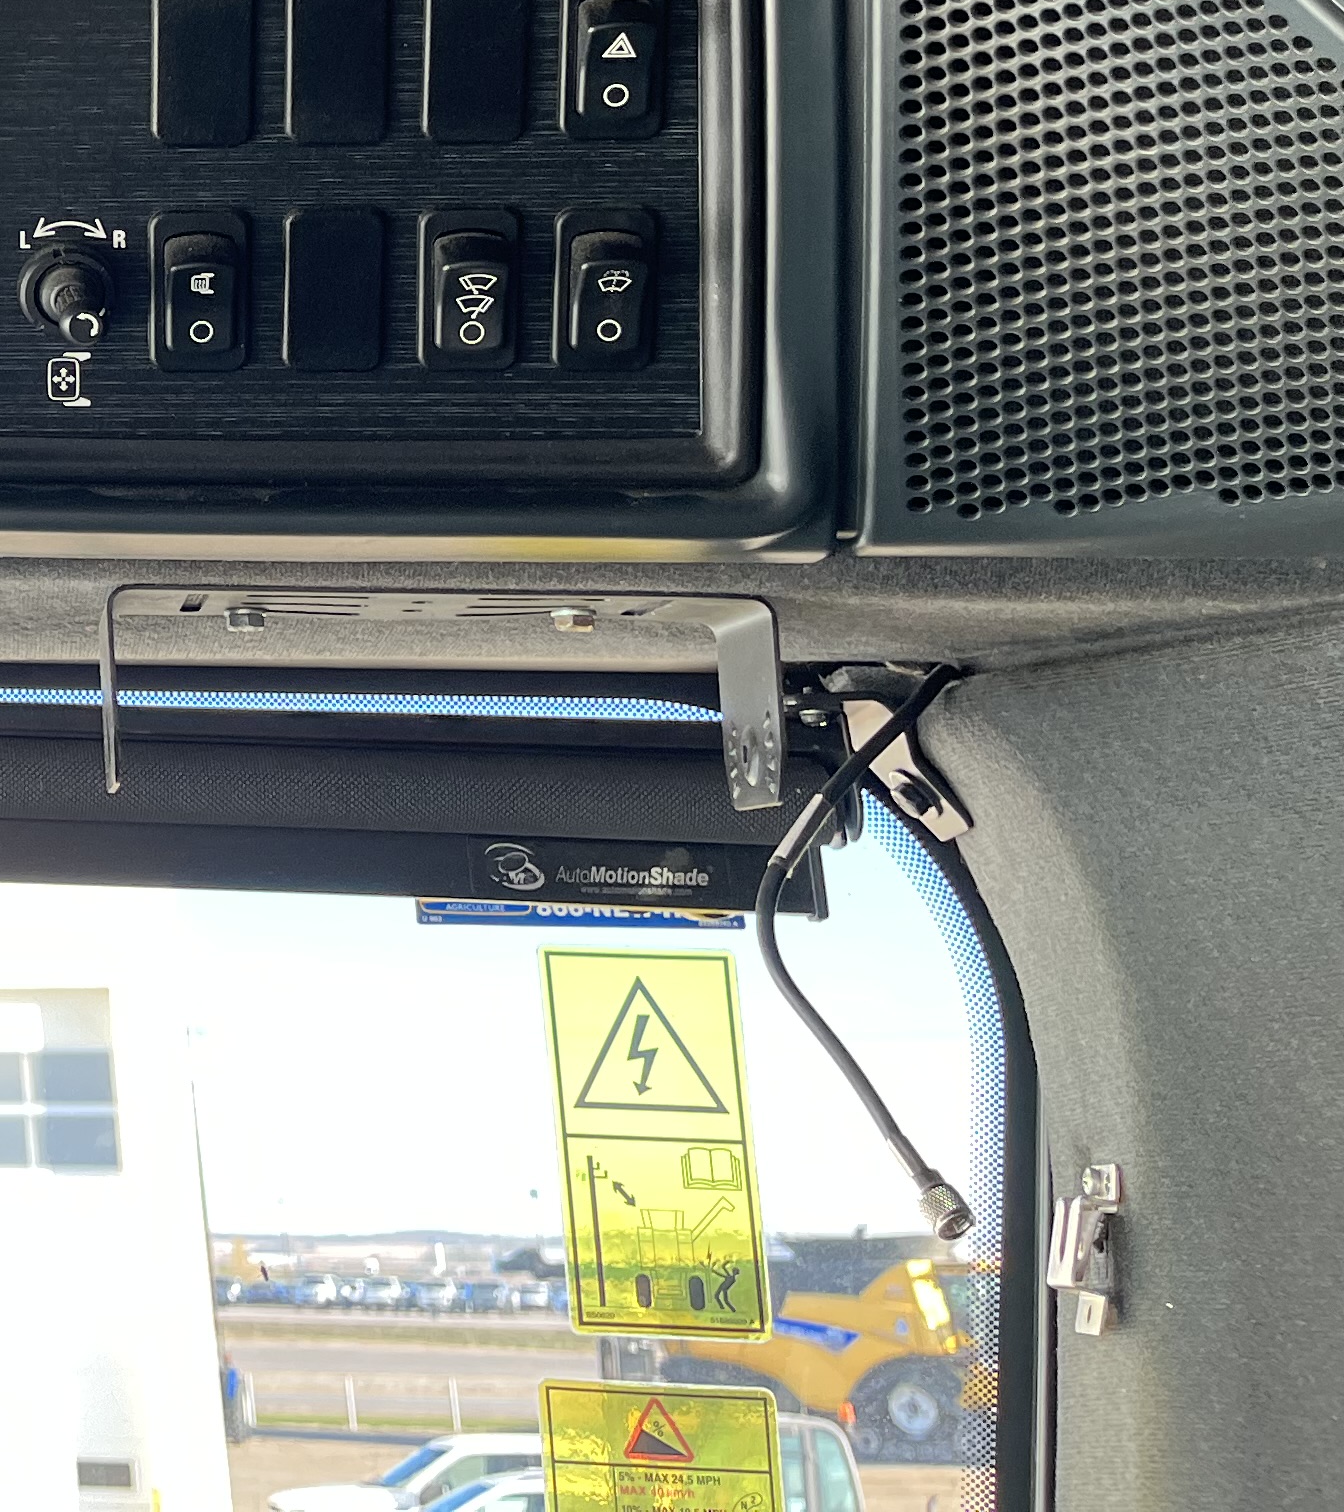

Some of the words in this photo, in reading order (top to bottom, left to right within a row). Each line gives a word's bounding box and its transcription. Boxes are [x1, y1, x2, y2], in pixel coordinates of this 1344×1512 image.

[19, 231, 31, 249] L
[112, 229, 127, 248] R
[555, 865, 710, 887] AutoMotionShade
[445, 903, 505, 913] AGRICULTURE
[644, 1472, 669, 1484] MAX
[696, 1475, 721, 1486] MPH
[620, 1484, 646, 1496] MAX
